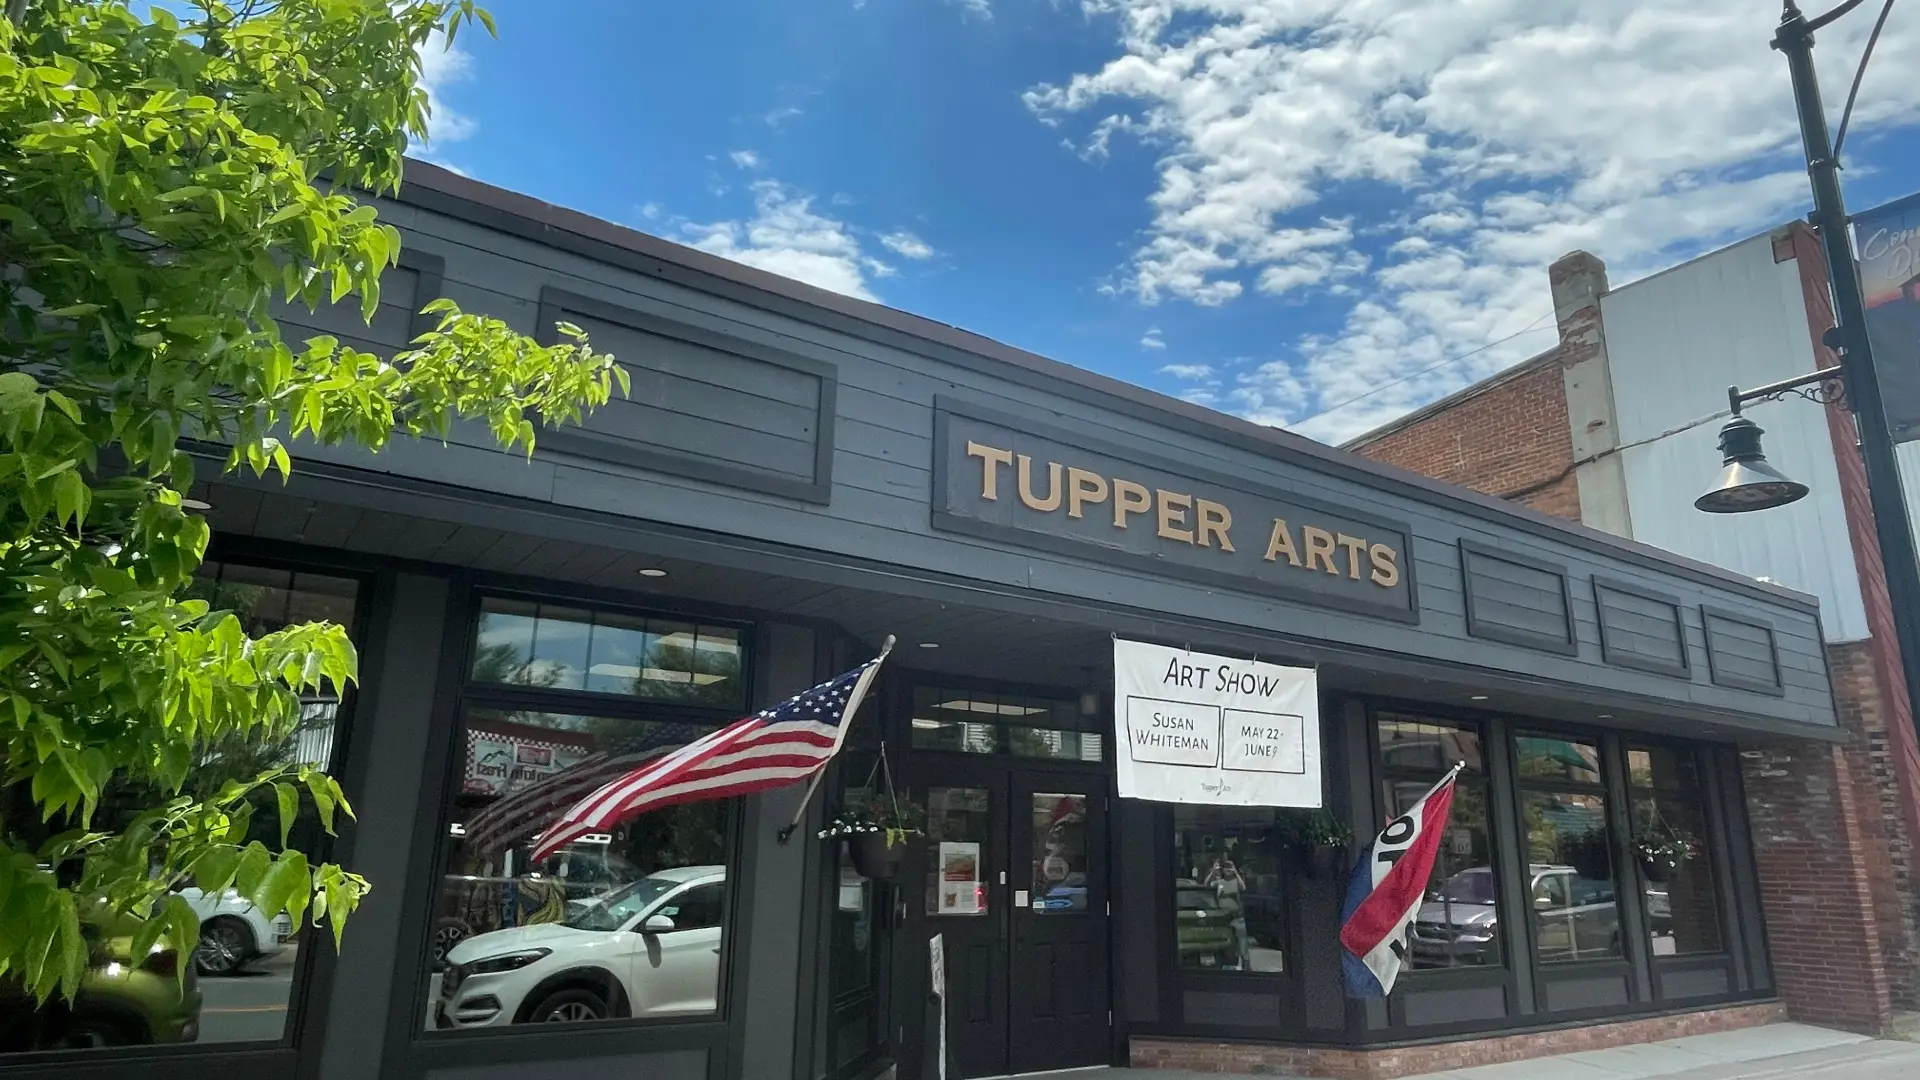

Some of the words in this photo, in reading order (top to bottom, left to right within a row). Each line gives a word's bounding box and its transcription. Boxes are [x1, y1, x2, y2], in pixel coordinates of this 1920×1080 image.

[967, 440, 1236, 553] TUPPER
[1263, 517, 1399, 588] ARTS
[1163, 657, 1210, 689] ART
[1215, 665, 1280, 698] SHOW
[1152, 712, 1194, 731] SUSAN
[1135, 729, 1209, 751] WHITEMAN
[1241, 725, 1265, 740] MAY
[1245, 743, 1271, 757] JUNE
